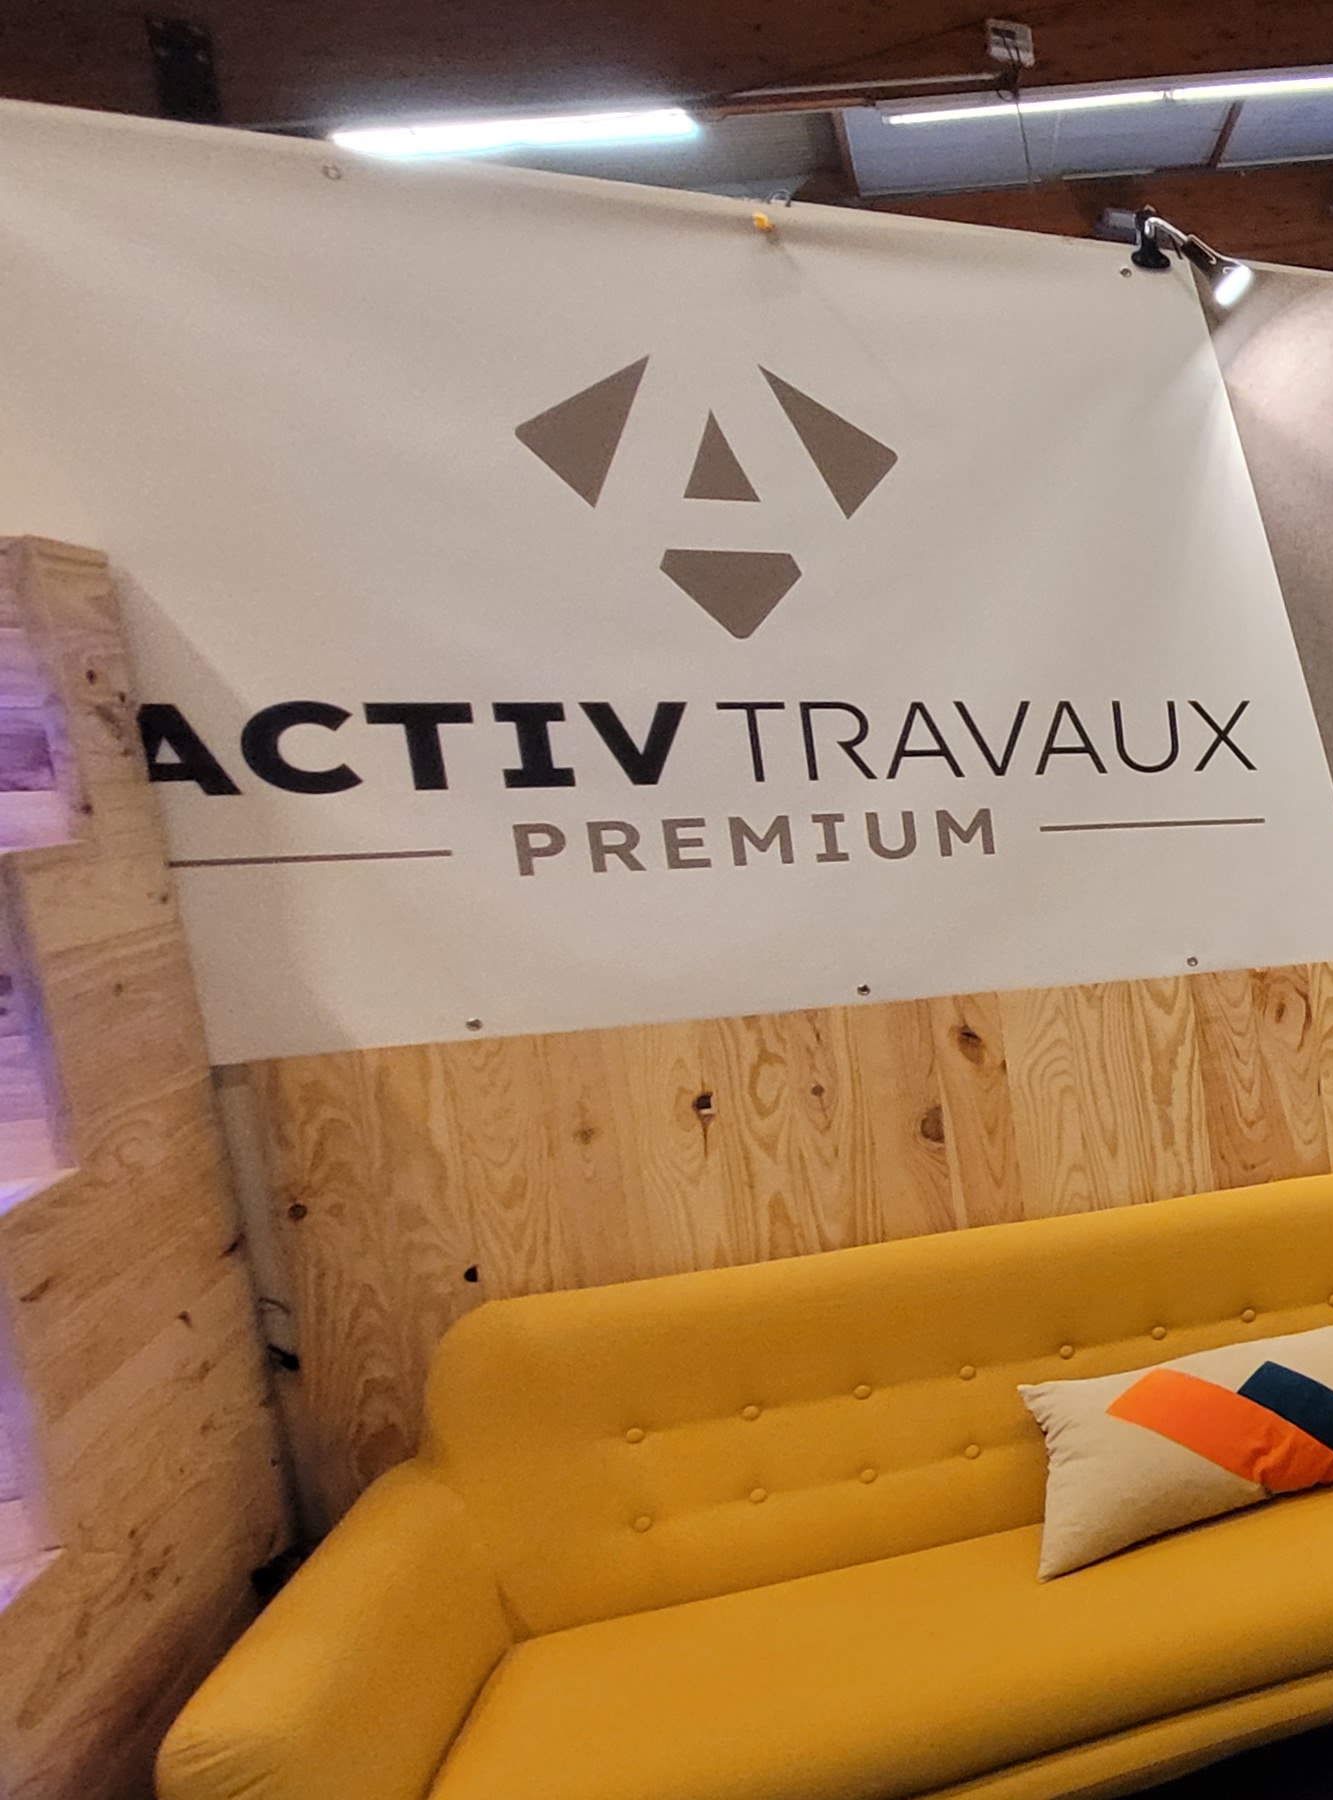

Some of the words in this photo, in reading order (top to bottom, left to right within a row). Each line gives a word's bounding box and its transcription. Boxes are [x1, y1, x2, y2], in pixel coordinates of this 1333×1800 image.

[137, 698, 687, 797] ACTIV
[716, 699, 1258, 783] TRAVAUX
[512, 806, 997, 877] PREMIUM
